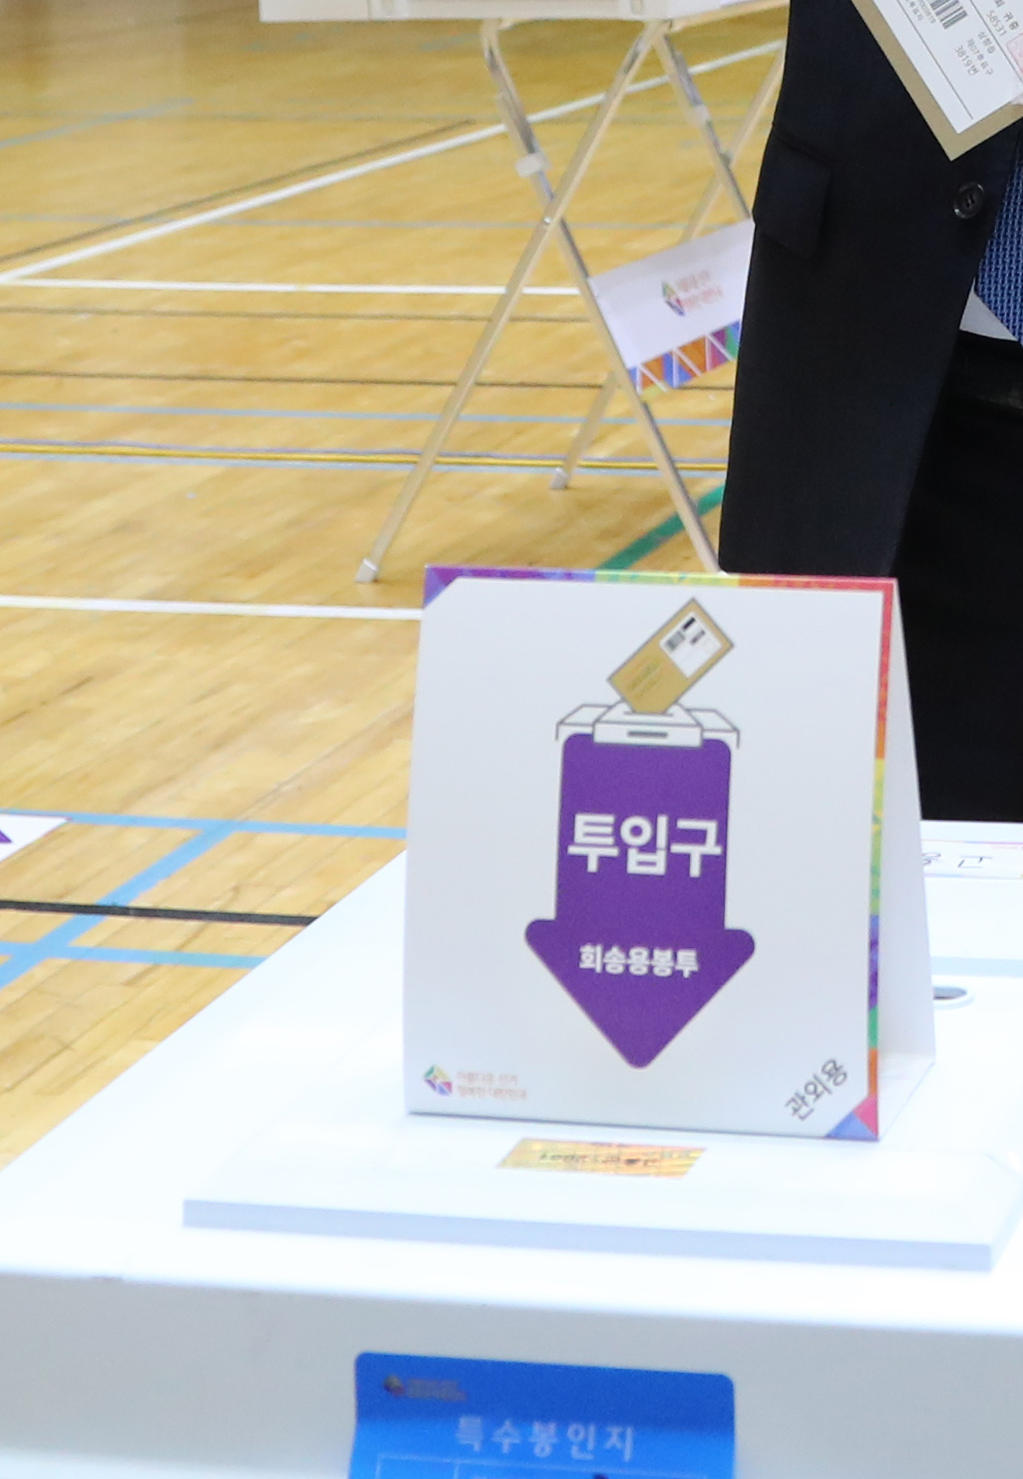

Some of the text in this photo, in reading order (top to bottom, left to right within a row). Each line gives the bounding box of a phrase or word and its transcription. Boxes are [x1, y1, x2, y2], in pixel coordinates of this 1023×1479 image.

[985, 9, 1007, 37] 58531
[1001, 10, 1019, 31] 귀중
[954, 45, 979, 77] 3819번
[566, 812, 723, 878] 투입구
[579, 942, 699, 978] 회송용봉투
[783, 1057, 850, 1120] 관외용
[456, 1415, 634, 1462] 특수봉인지
